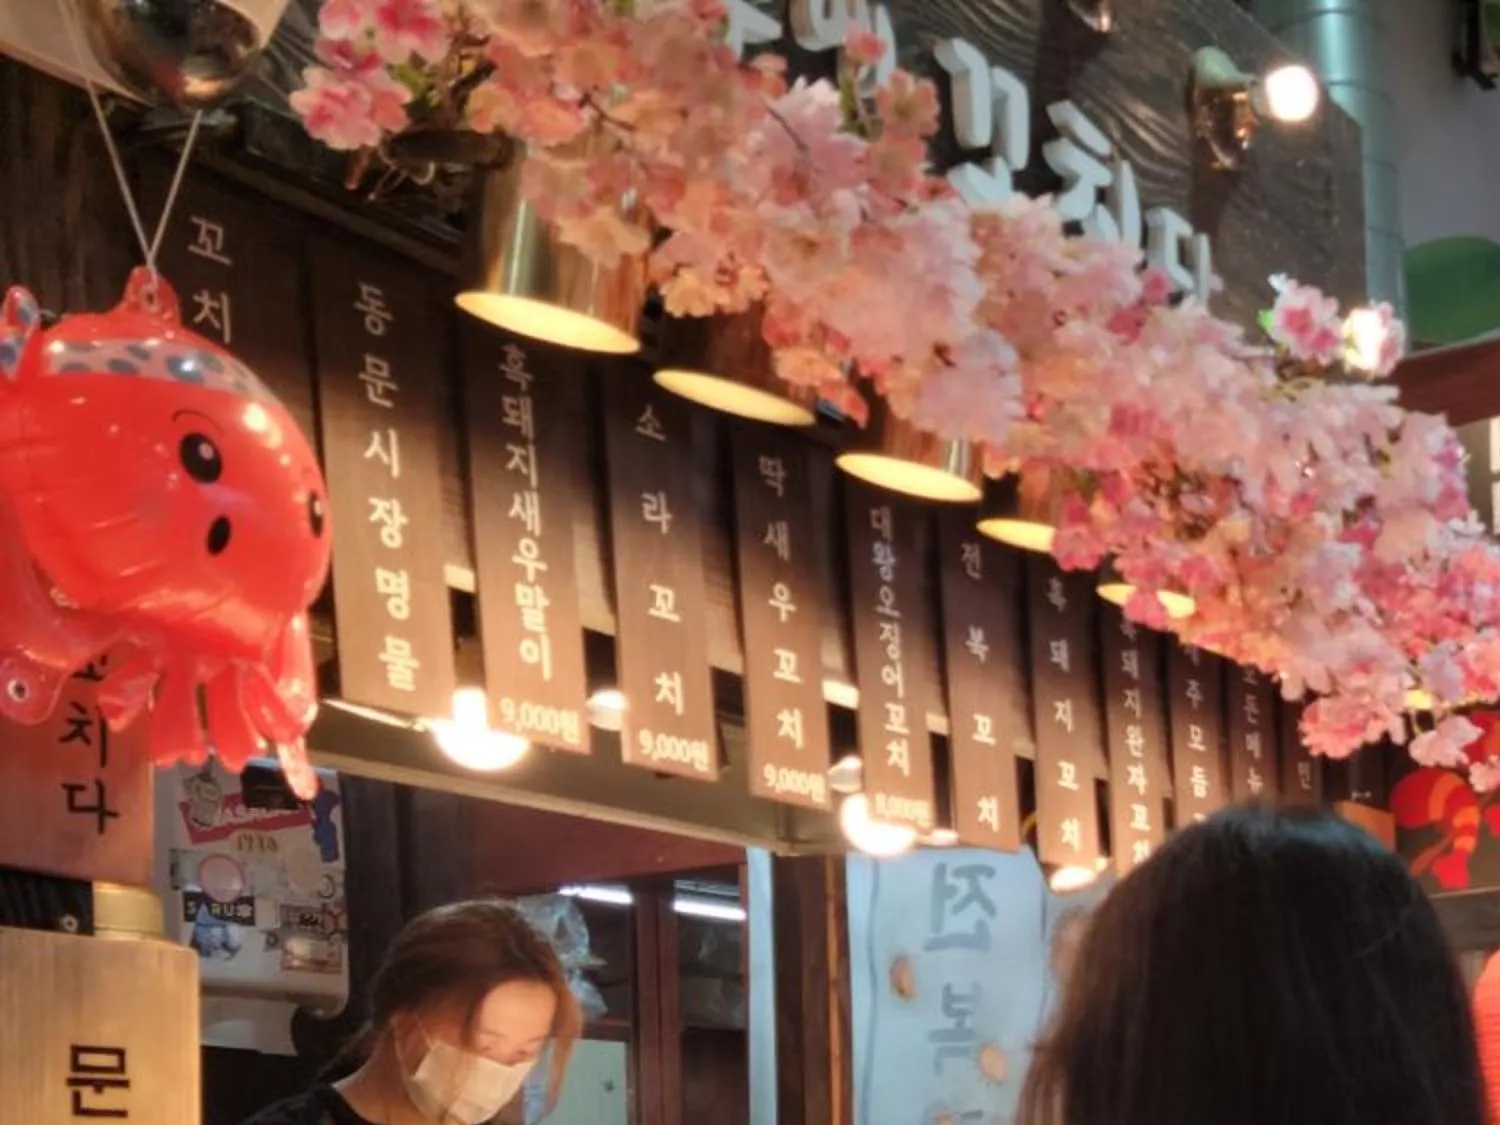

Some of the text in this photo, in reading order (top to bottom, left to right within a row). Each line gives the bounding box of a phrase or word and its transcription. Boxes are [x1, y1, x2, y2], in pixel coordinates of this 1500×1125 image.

[634, 404, 684, 715] 소라꼬치
[759, 456, 803, 749] 딱새우꼬치
[959, 542, 1000, 831] 전복꼬치
